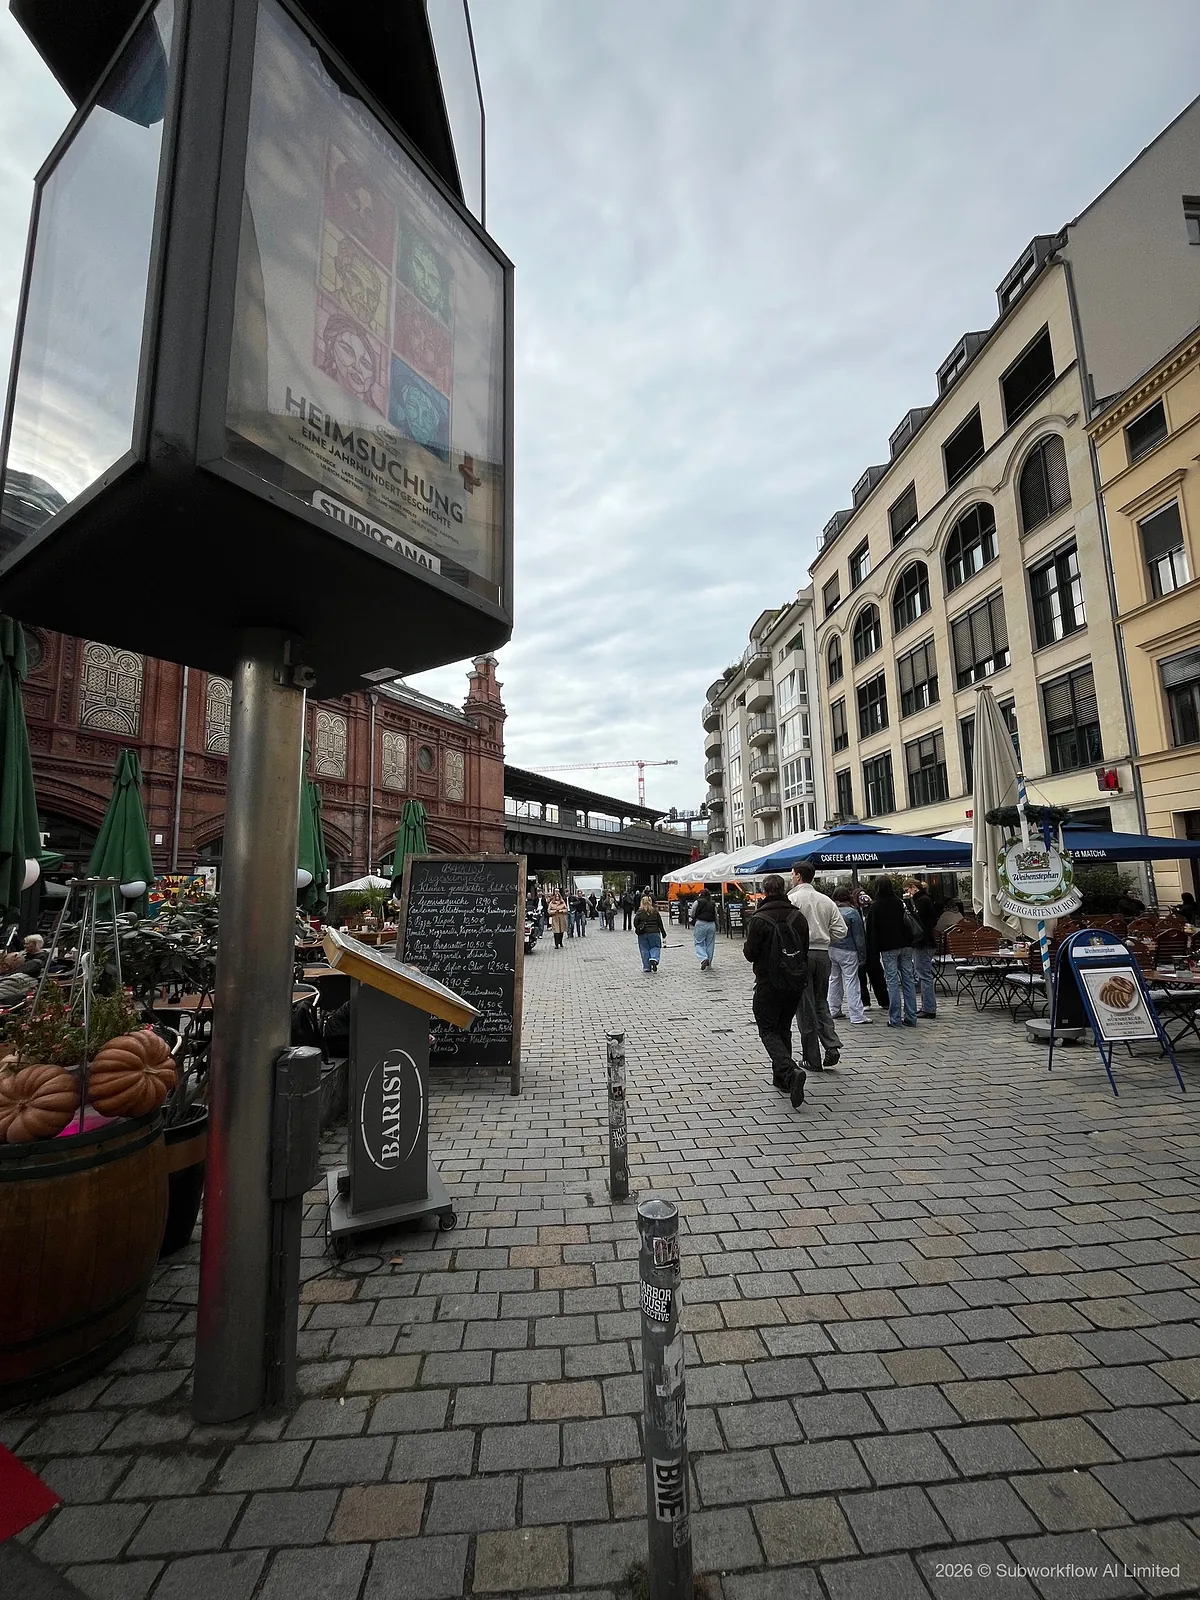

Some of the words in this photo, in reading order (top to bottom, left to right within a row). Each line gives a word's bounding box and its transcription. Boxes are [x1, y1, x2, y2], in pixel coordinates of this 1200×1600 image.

[359, 115, 421, 191] OKTOBER
[425, 191, 440, 212] IM
[443, 211, 470, 246] KINO
[286, 386, 463, 524] HEIMSUCHUNG
[302, 426, 327, 450] EINE
[329, 445, 452, 529] JAHRHUNDERTGESCHICHTE
[320, 498, 433, 570] STUDIOCANAL
[820, 854, 844, 862] COFFEE
[852, 853, 879, 861] MATCHA
[1081, 850, 1107, 858] MATCHA
[1012, 871, 1059, 881] Weihenstephan
[1003, 900, 1052, 917] BIERGARTEN
[1052, 904, 1063, 915] IM
[1063, 897, 1077, 911] HOF
[414, 916, 432, 929] Pizza
[414, 939, 430, 953] Pizza
[466, 940, 485, 949] 10,50
[486, 940, 494, 949] €
[462, 977, 471, 987] €
[382, 1061, 401, 1161] BARIST
[656, 1463, 684, 1518] BNE
